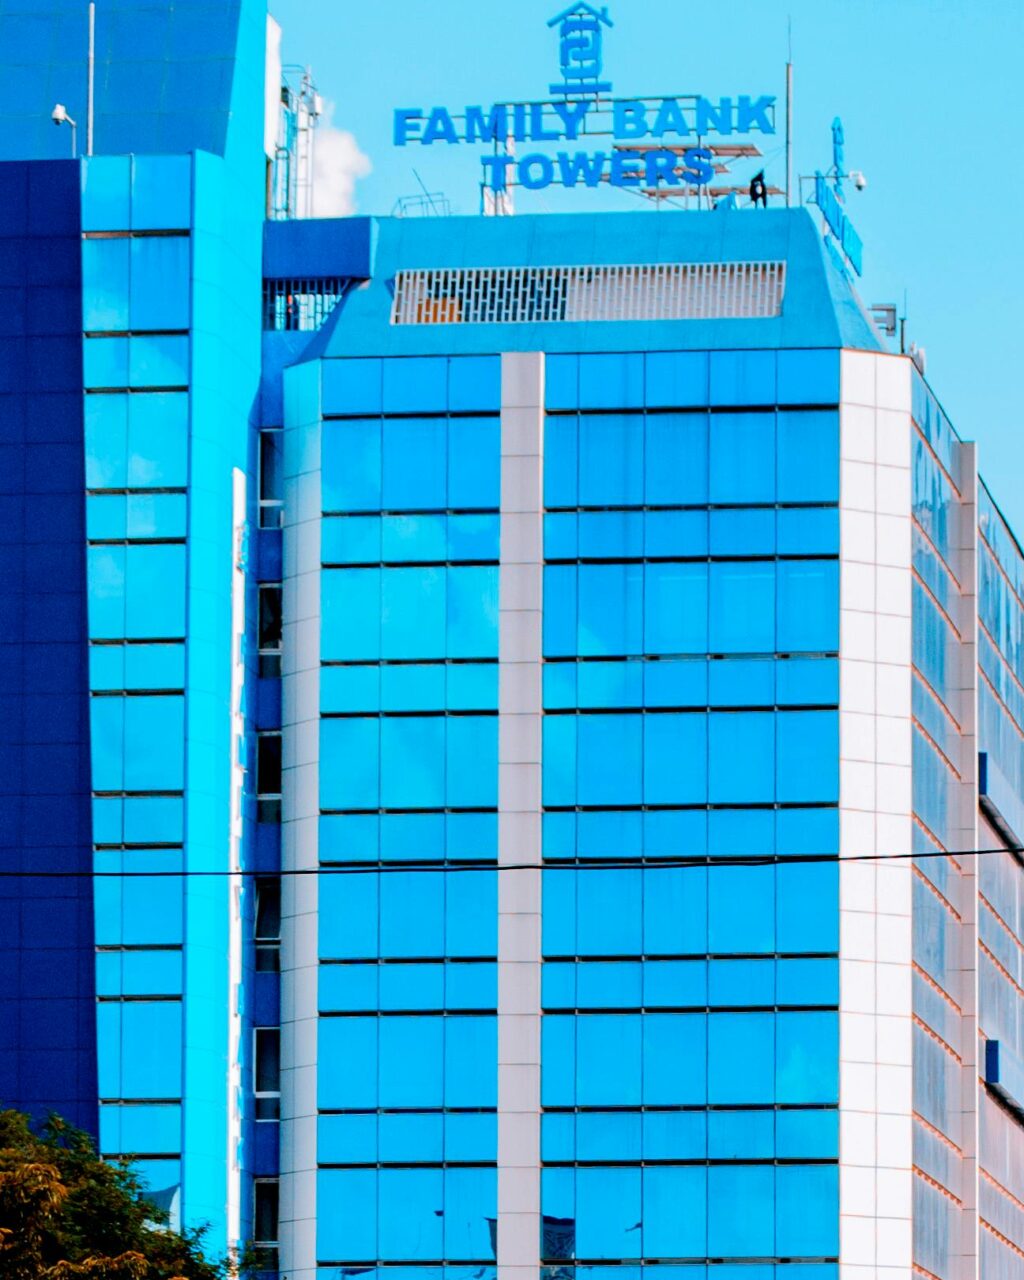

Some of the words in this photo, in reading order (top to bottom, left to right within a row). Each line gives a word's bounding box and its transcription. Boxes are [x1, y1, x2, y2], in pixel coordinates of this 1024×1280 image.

[394, 102, 591, 146] FAMILY
[613, 95, 777, 139] BANK
[481, 148, 715, 191] TOWERS
